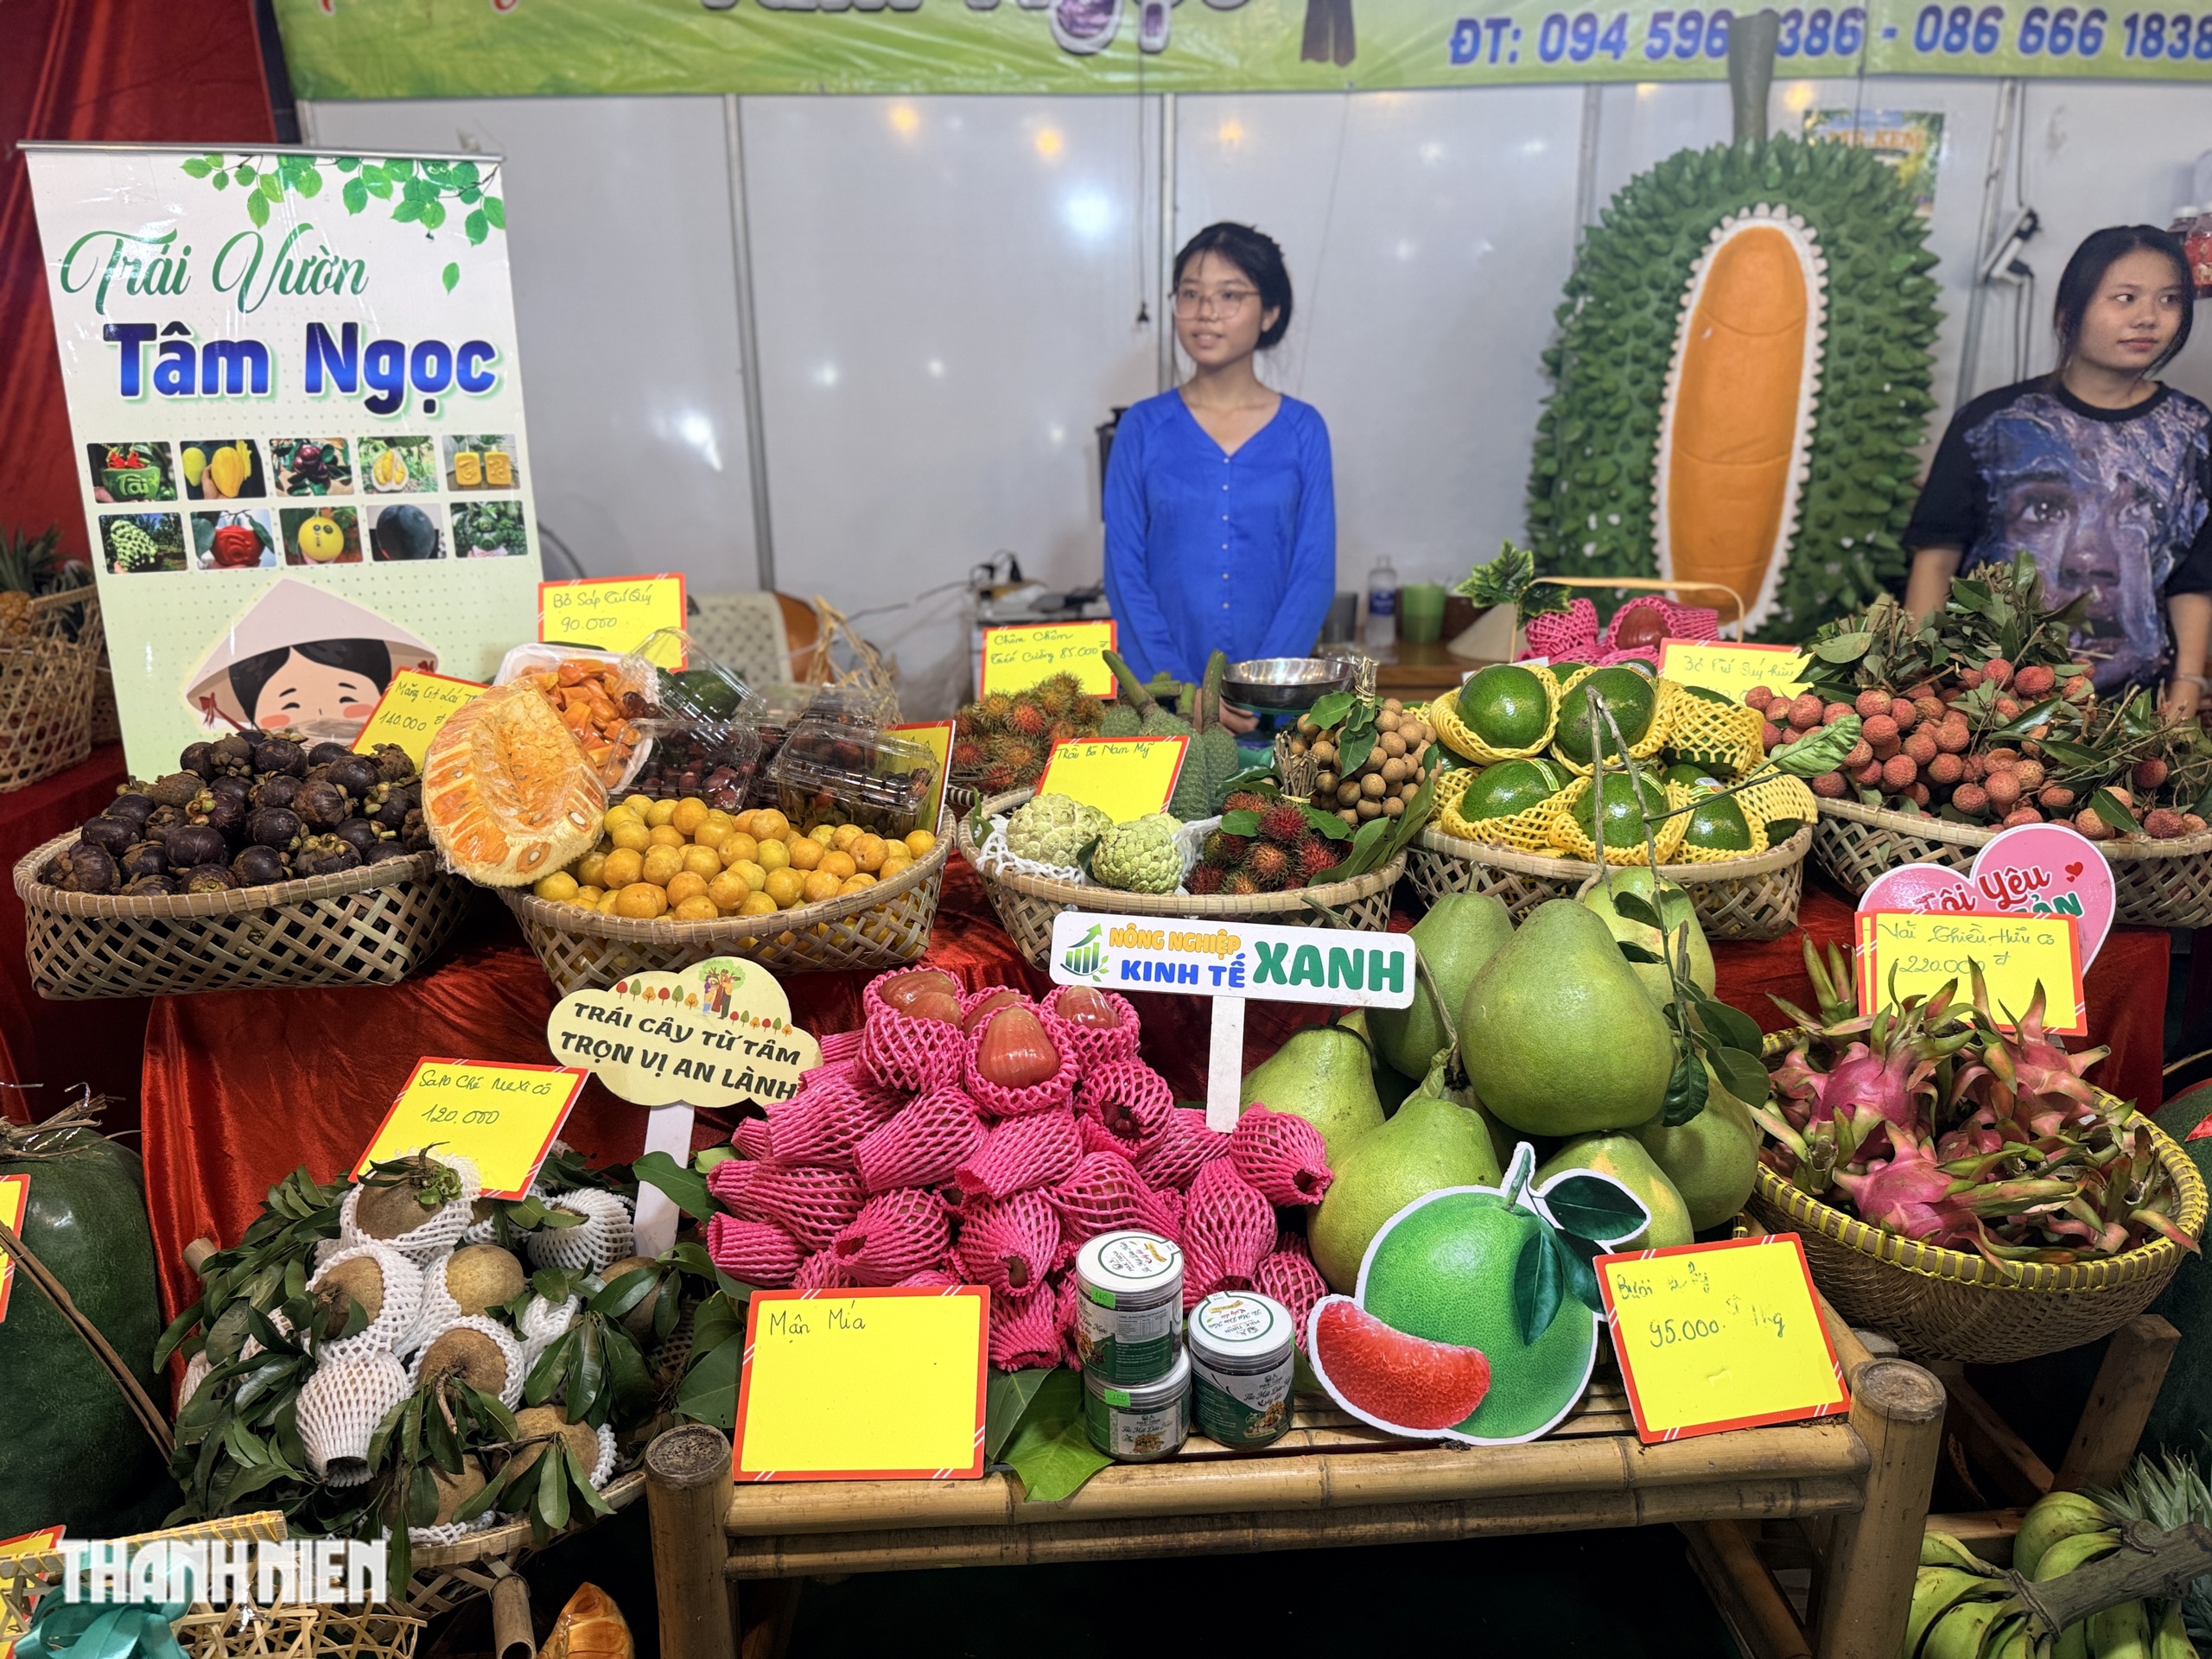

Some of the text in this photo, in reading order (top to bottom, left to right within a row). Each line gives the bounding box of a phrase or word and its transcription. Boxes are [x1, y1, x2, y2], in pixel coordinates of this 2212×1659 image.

[1450, 17, 1521, 65] ĐT:
[1538, 11, 1628, 62] 094
[1759, 8, 1866, 57] 386
[1914, 5, 2004, 54] 086
[2018, 7, 2107, 55] 666
[2124, 12, 2212, 60] 1838
[60, 222, 370, 315] Trái Vườn
[103, 321, 497, 416] Tâm Ngọc
[561, 616, 618, 632] 90.000
[1979, 867, 2050, 908] Yêu
[1109, 923, 1242, 960] NÔNG NGHIỆP
[1121, 953, 1246, 988] KINH TẾ
[1252, 940, 1405, 993] XANH
[575, 1002, 801, 1065] TRÁI CÂY TỪ TÂM
[561, 1031, 799, 1100] TRỌN VỊ AN LÀNH
[421, 1103, 500, 1124] 120.000
[828, 1300, 867, 1330] Mía
